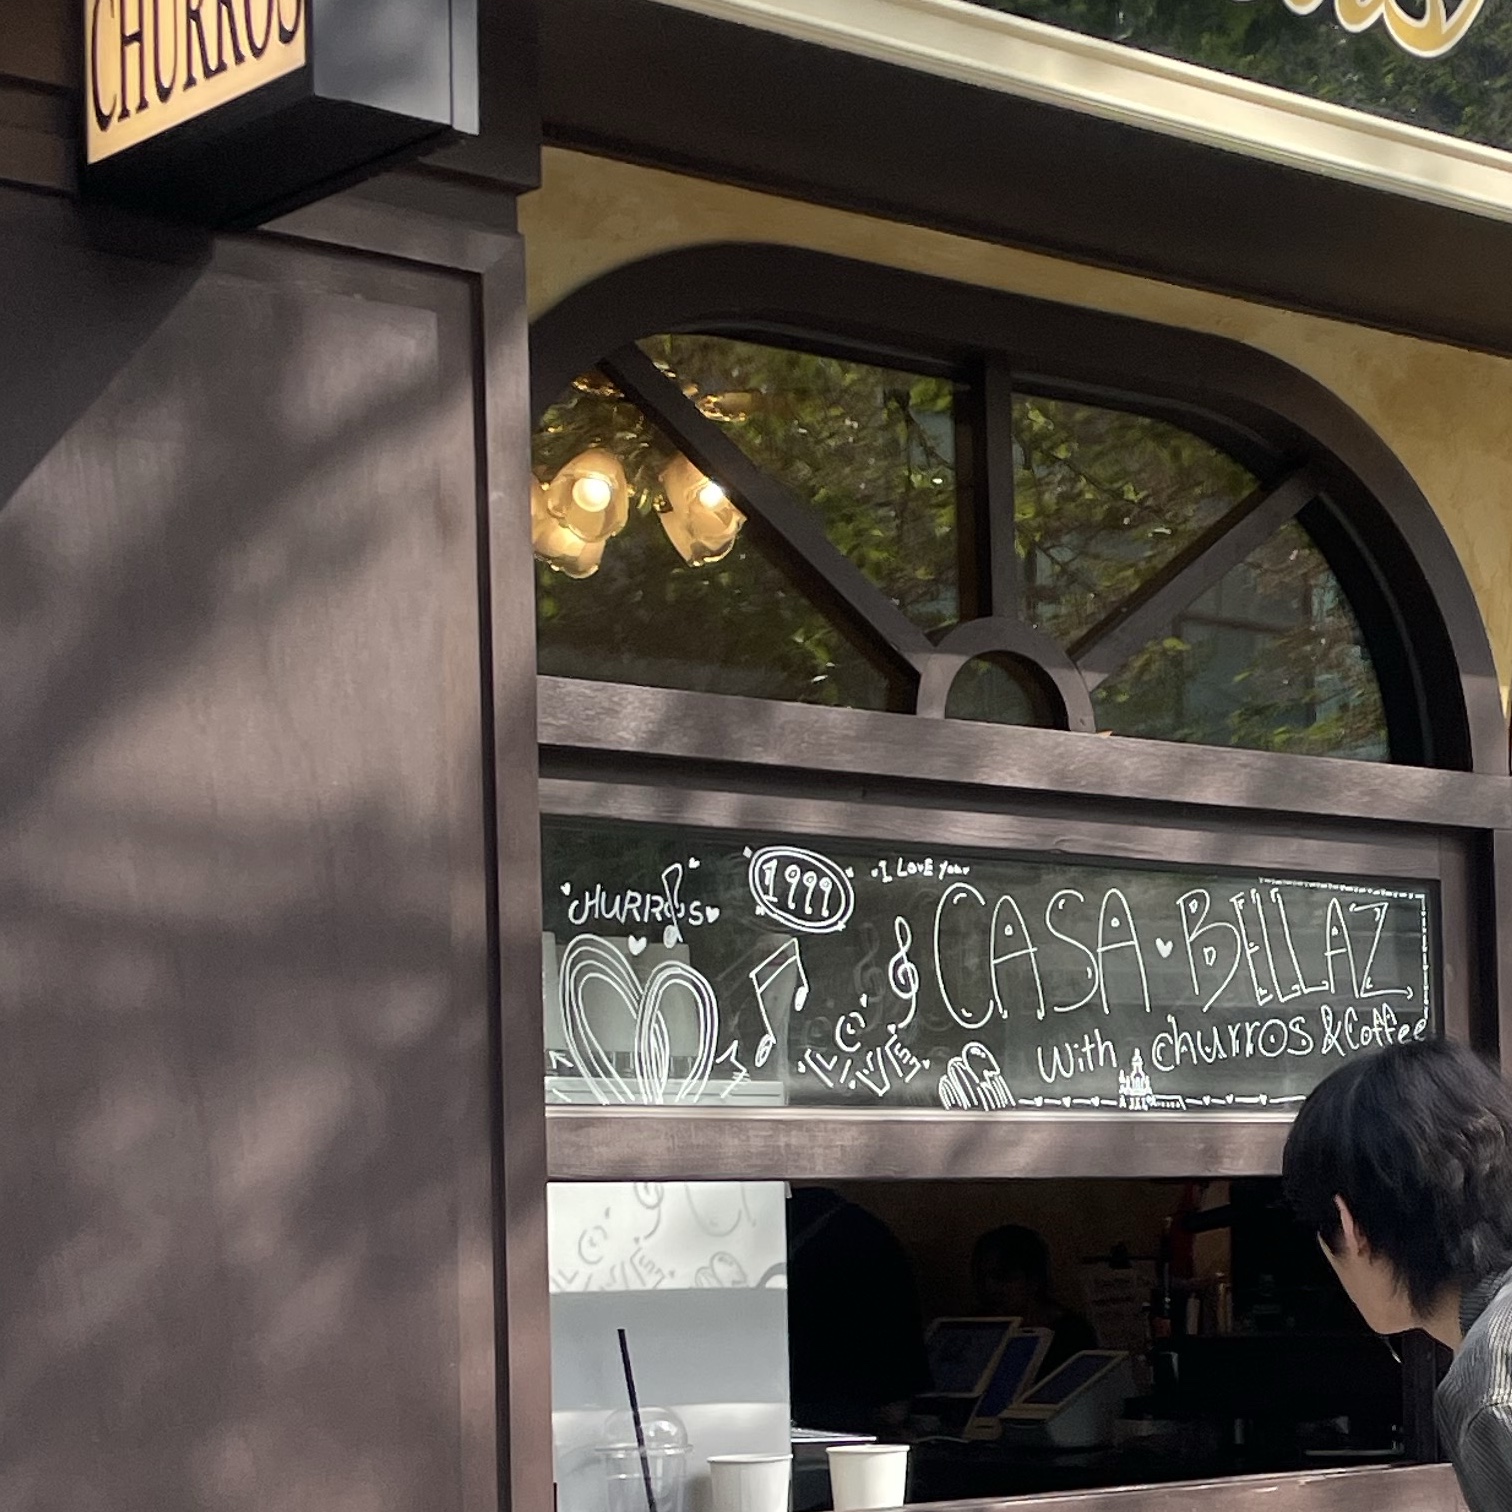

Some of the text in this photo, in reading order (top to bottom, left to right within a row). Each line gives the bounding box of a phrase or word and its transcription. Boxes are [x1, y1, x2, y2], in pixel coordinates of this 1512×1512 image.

[761, 859, 833, 917] 1999
[934, 882, 1414, 1029] CASA BELLAZ
